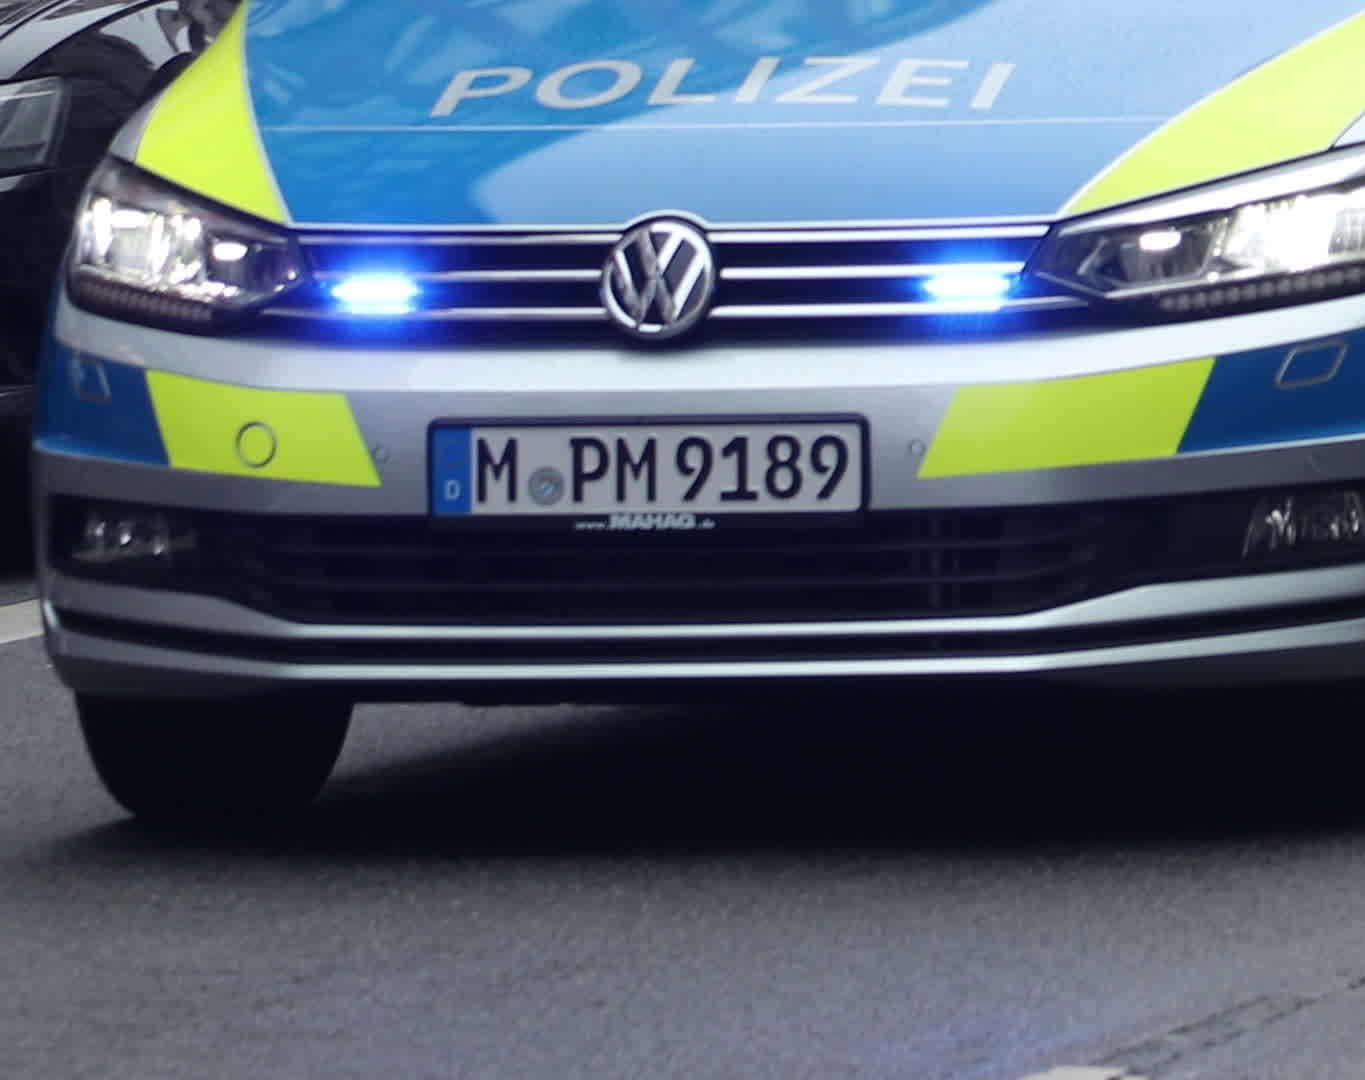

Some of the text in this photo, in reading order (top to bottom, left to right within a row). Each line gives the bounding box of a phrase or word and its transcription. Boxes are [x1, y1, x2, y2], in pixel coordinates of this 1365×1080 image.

[430, 56, 1015, 117] POLIZEI
[476, 434, 850, 503] M PM 9189
